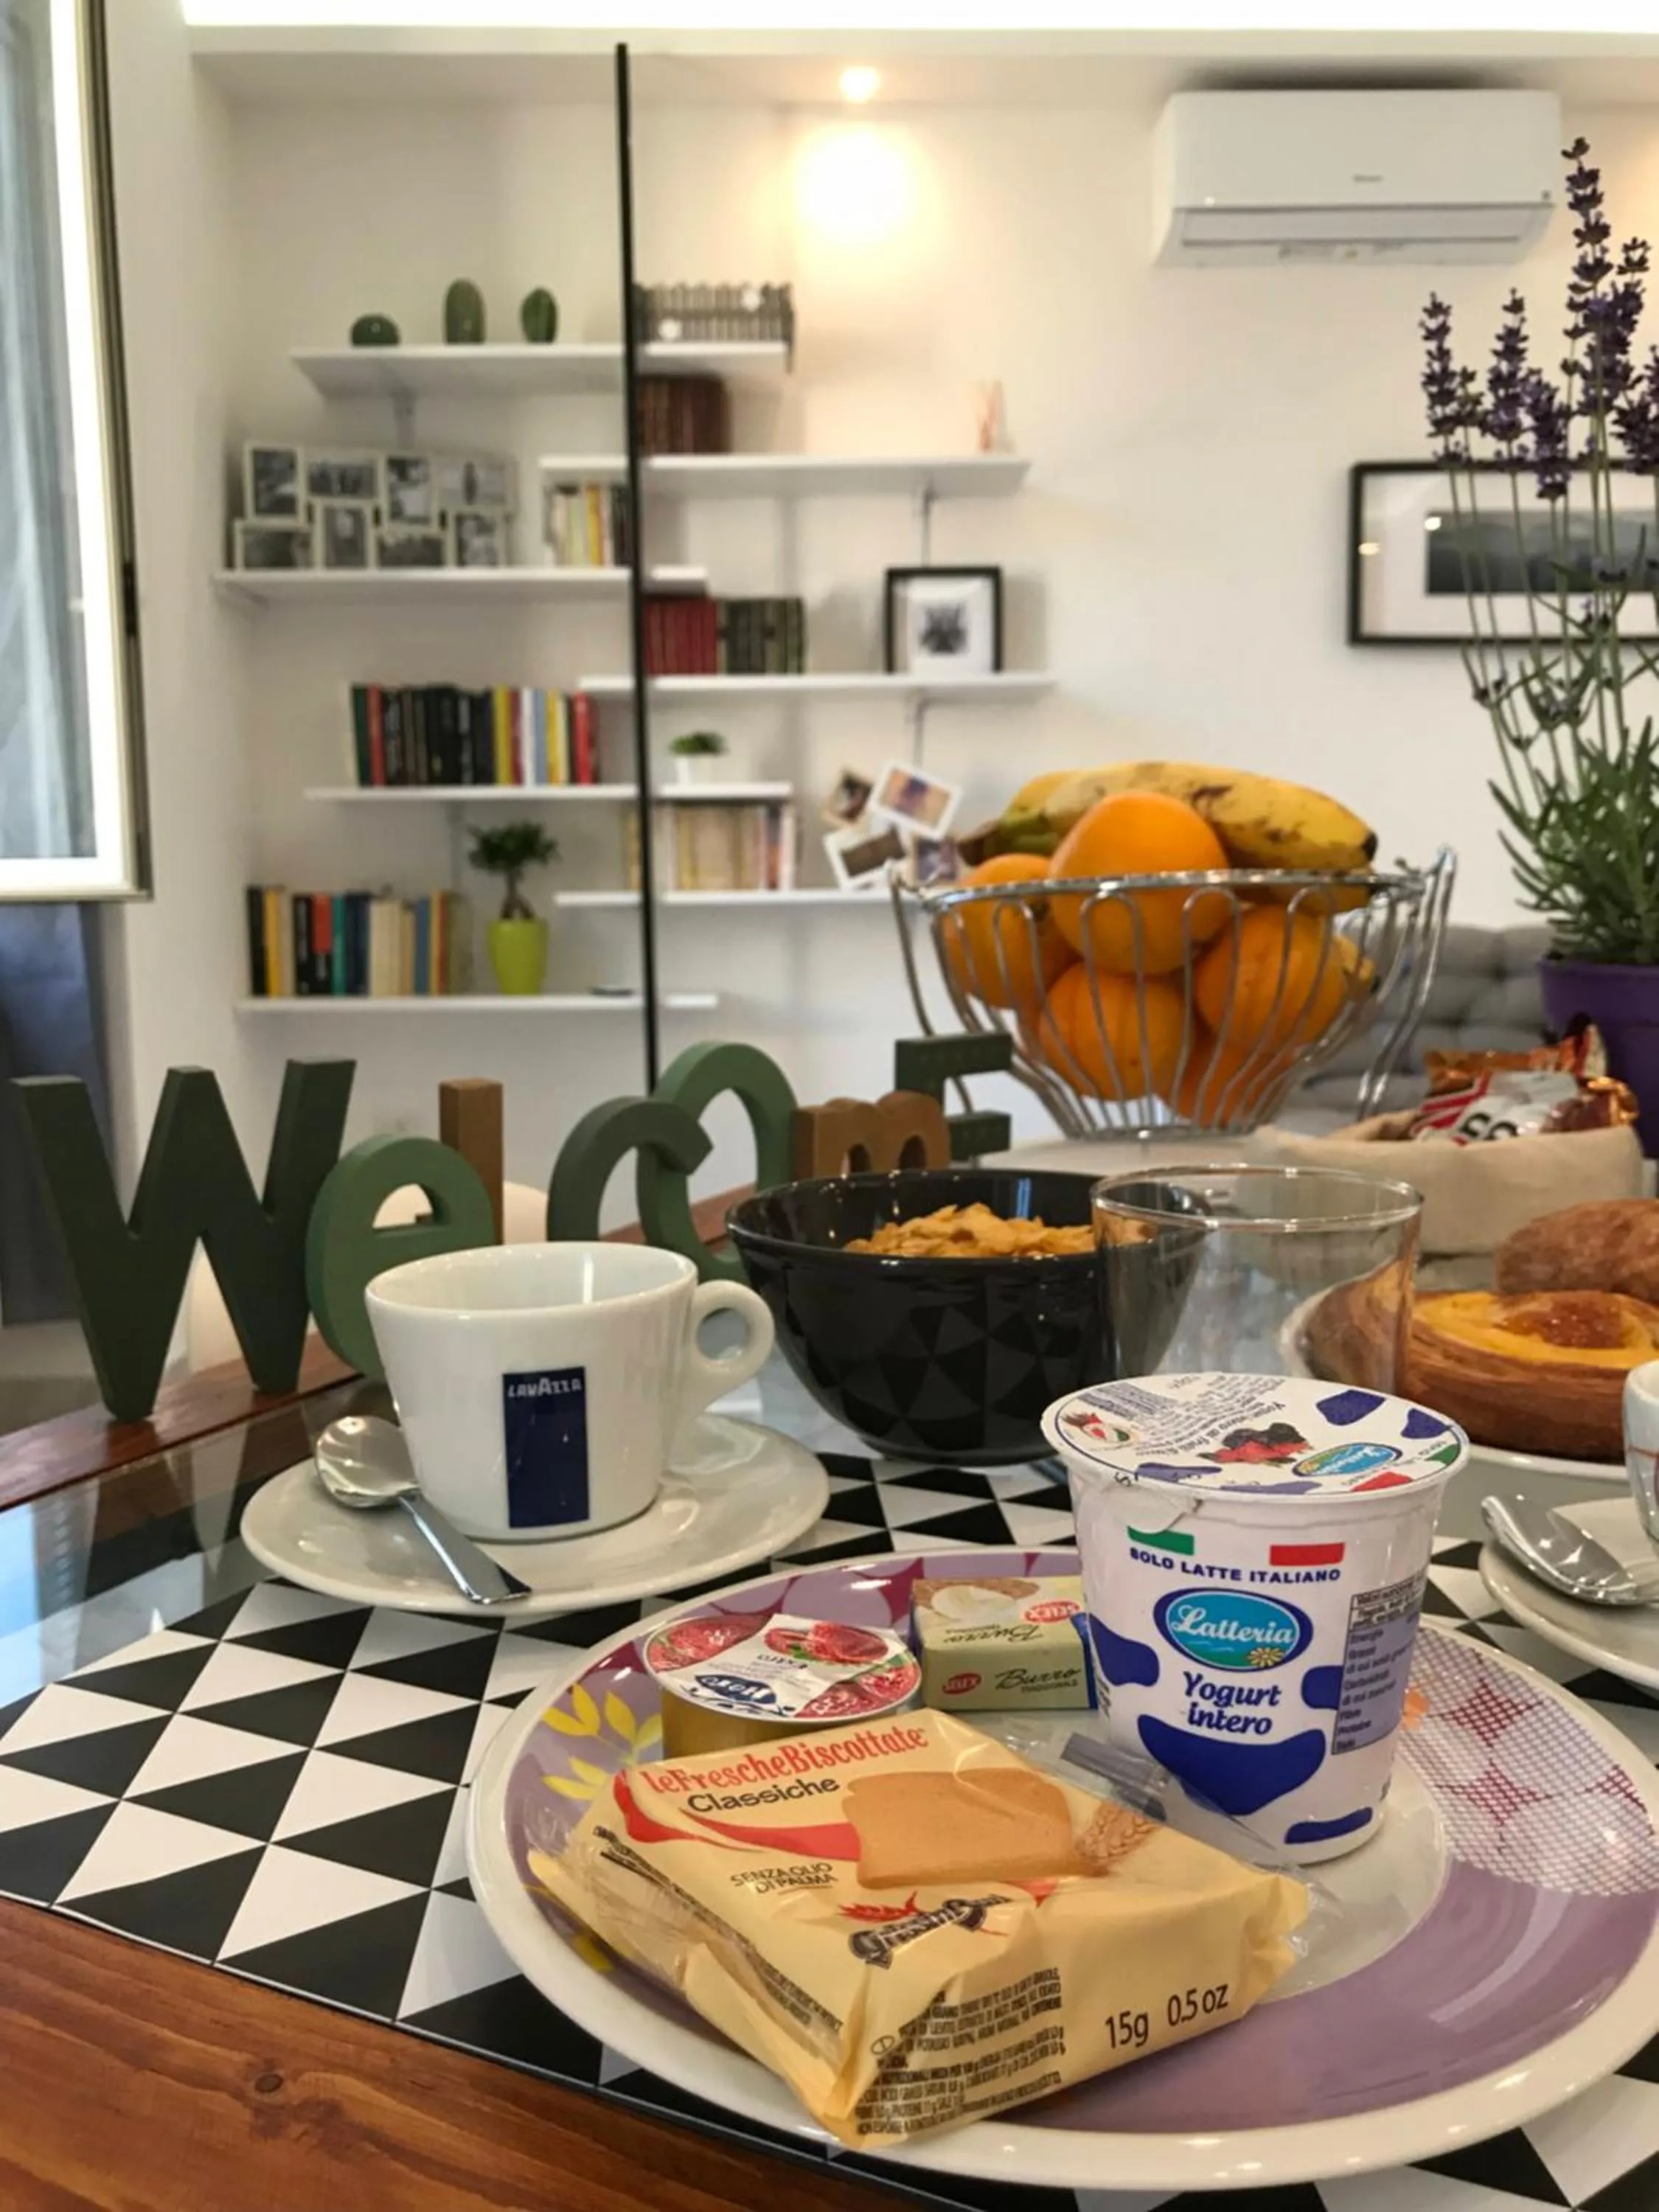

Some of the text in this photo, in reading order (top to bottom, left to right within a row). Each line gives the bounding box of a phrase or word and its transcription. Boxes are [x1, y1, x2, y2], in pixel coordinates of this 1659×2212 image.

[507, 1377, 582, 1398] LAVAZZA
[1129, 1546, 1341, 1584] SOLO LATTE ITALIANO
[1170, 1604, 1293, 1644] Latteria
[994, 1668, 1082, 1690] Burro
[1183, 1670, 1282, 1708] Yogurt
[1186, 1702, 1273, 1736] intero
[687, 1775, 841, 1814] Classiche
[729, 1866, 789, 1888] SENZA
[756, 1873, 838, 1895] DI PALMA
[1105, 2010, 1150, 2049] 15g
[1203, 1983, 1229, 2014] oz
